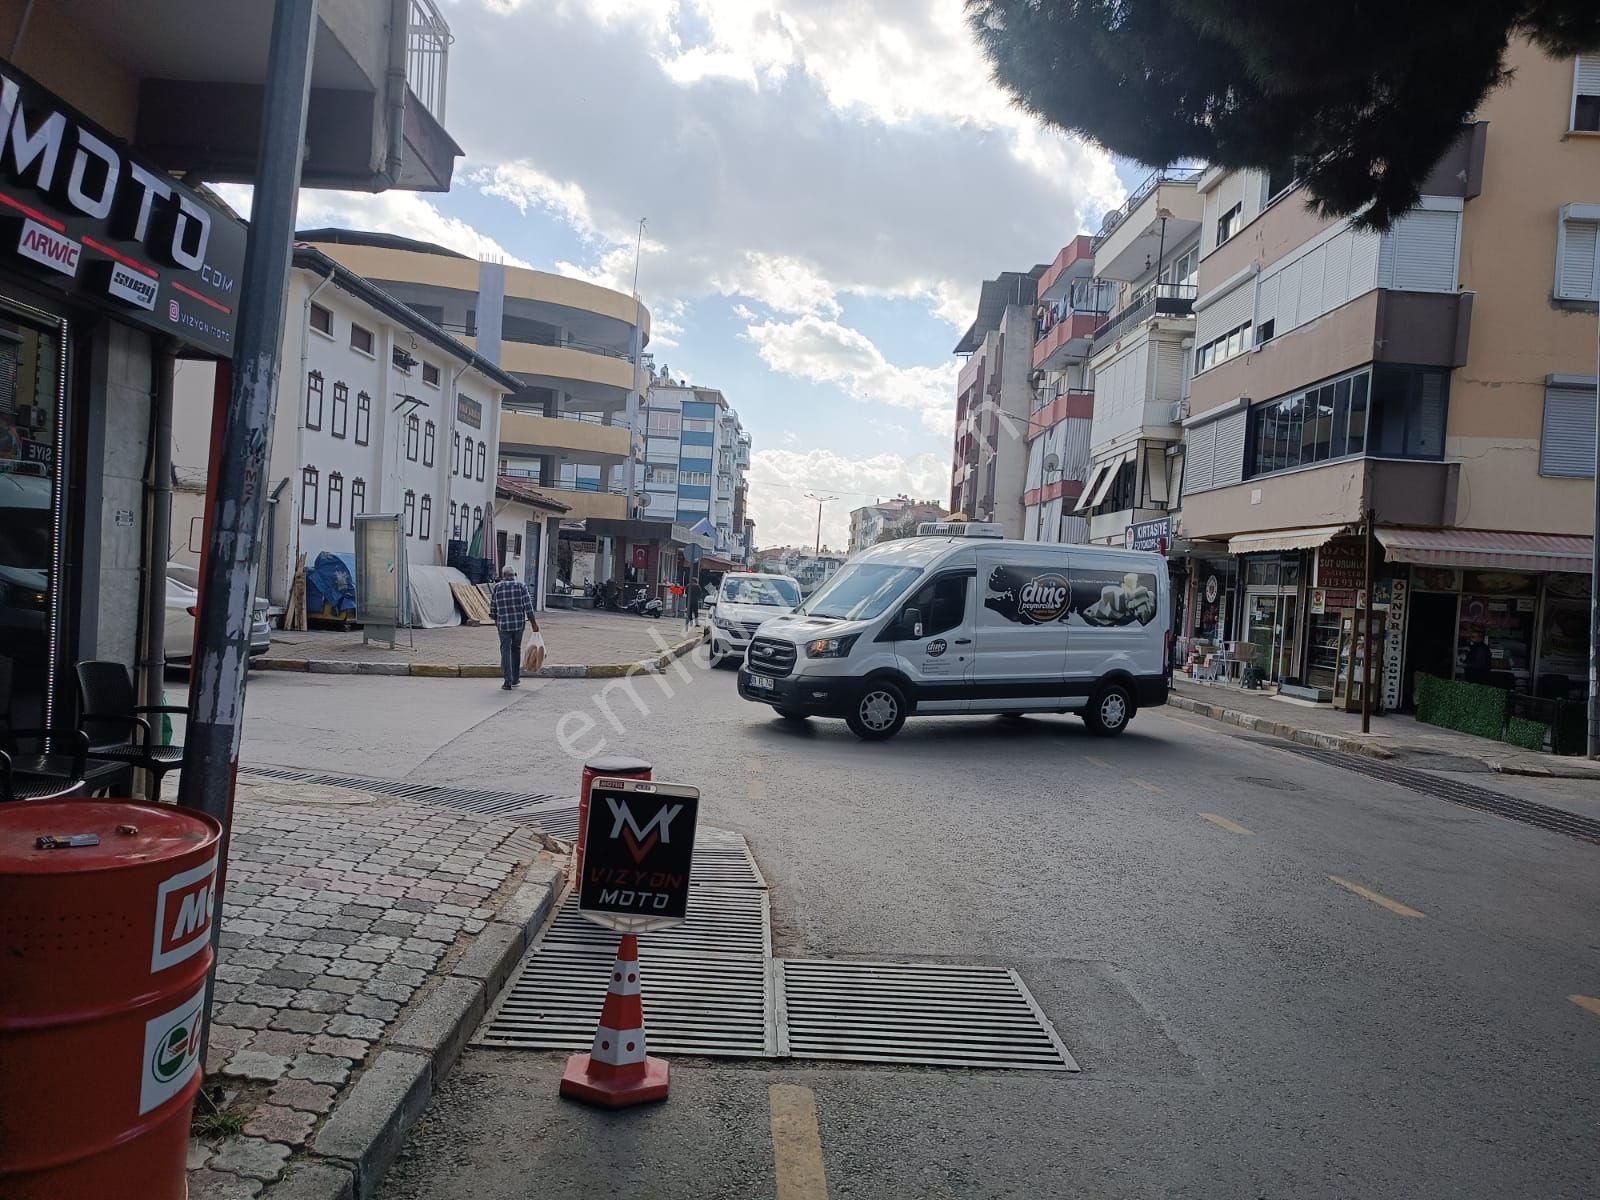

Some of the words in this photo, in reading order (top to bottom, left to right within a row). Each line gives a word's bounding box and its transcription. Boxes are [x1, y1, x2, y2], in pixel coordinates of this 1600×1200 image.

[0, 74, 210, 271] MOTO
[590, 867, 683, 889] VIZYON
[598, 888, 670, 909] MOTO
